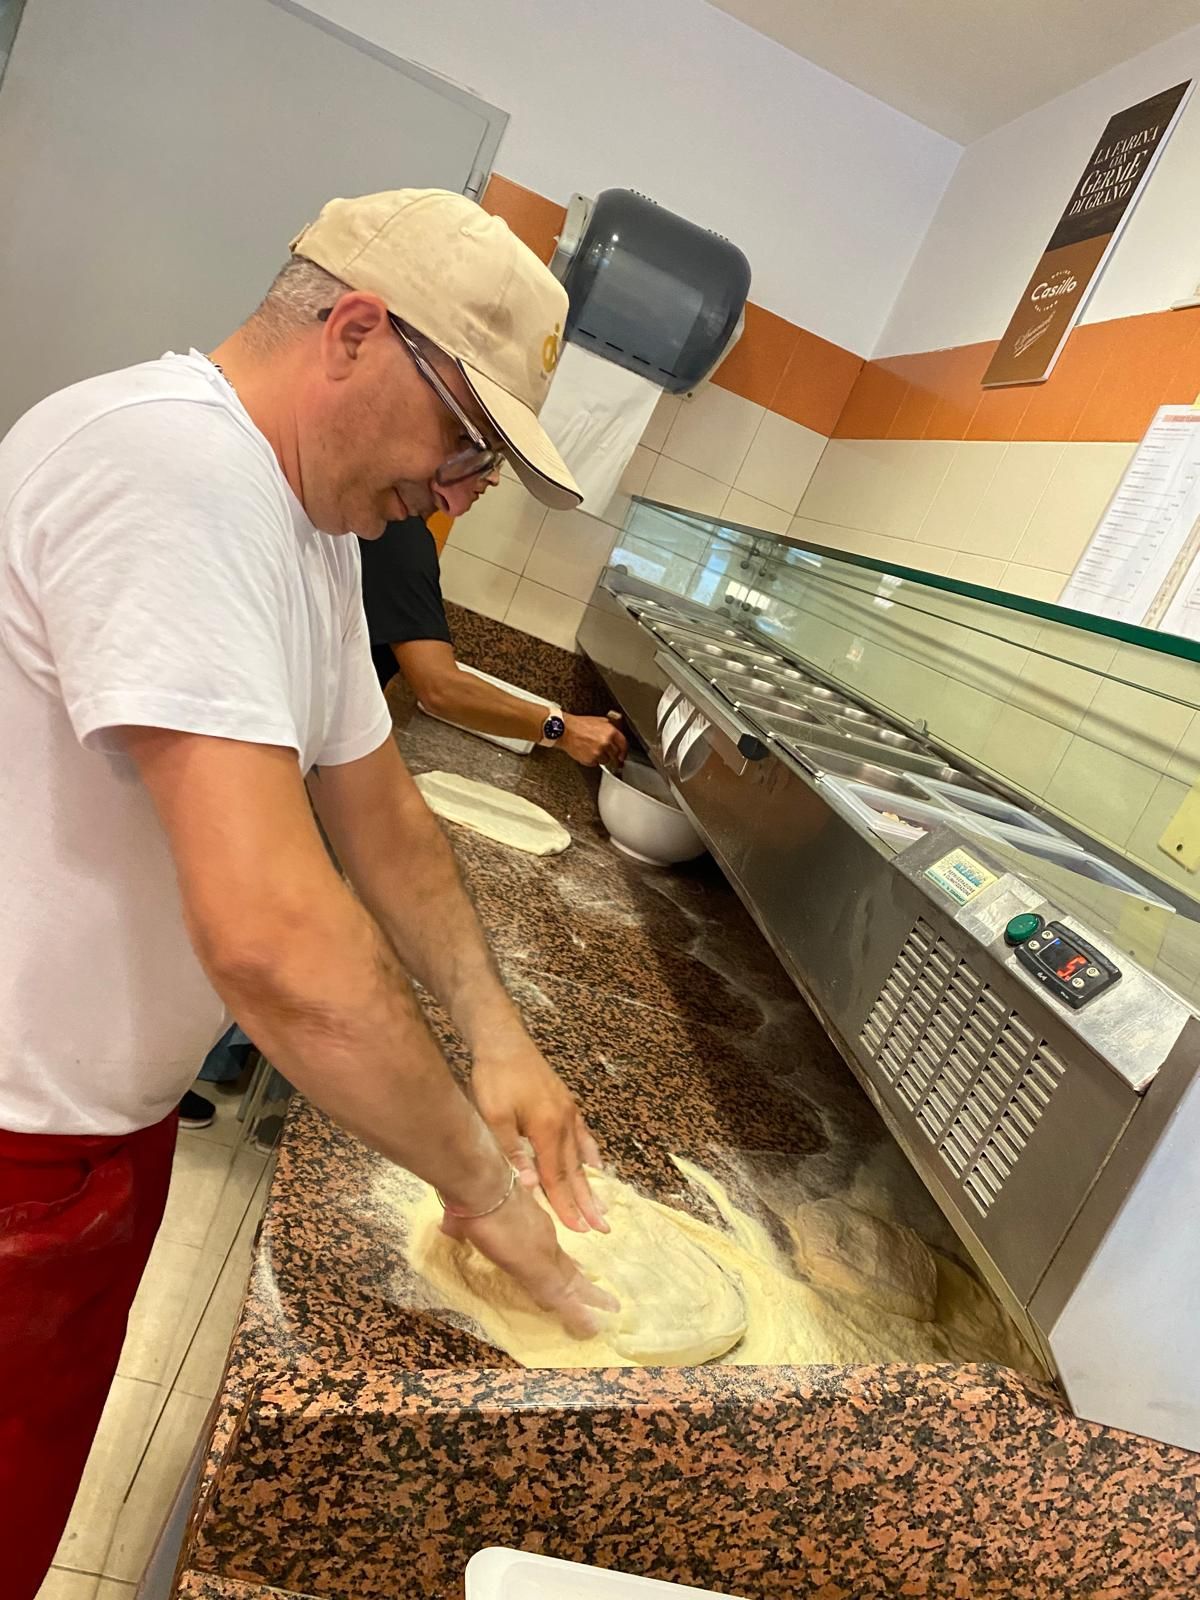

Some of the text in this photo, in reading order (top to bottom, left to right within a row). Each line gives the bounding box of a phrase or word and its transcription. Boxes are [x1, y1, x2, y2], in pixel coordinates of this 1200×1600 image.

[1094, 125, 1159, 165] LA FARINA
[1109, 150, 1131, 168] CON
[1080, 149, 1148, 197] GERME
[1069, 180, 1132, 216] DI GRANO
[1031, 275, 1078, 301] Casillo
[1056, 954, 1087, 980] 5
